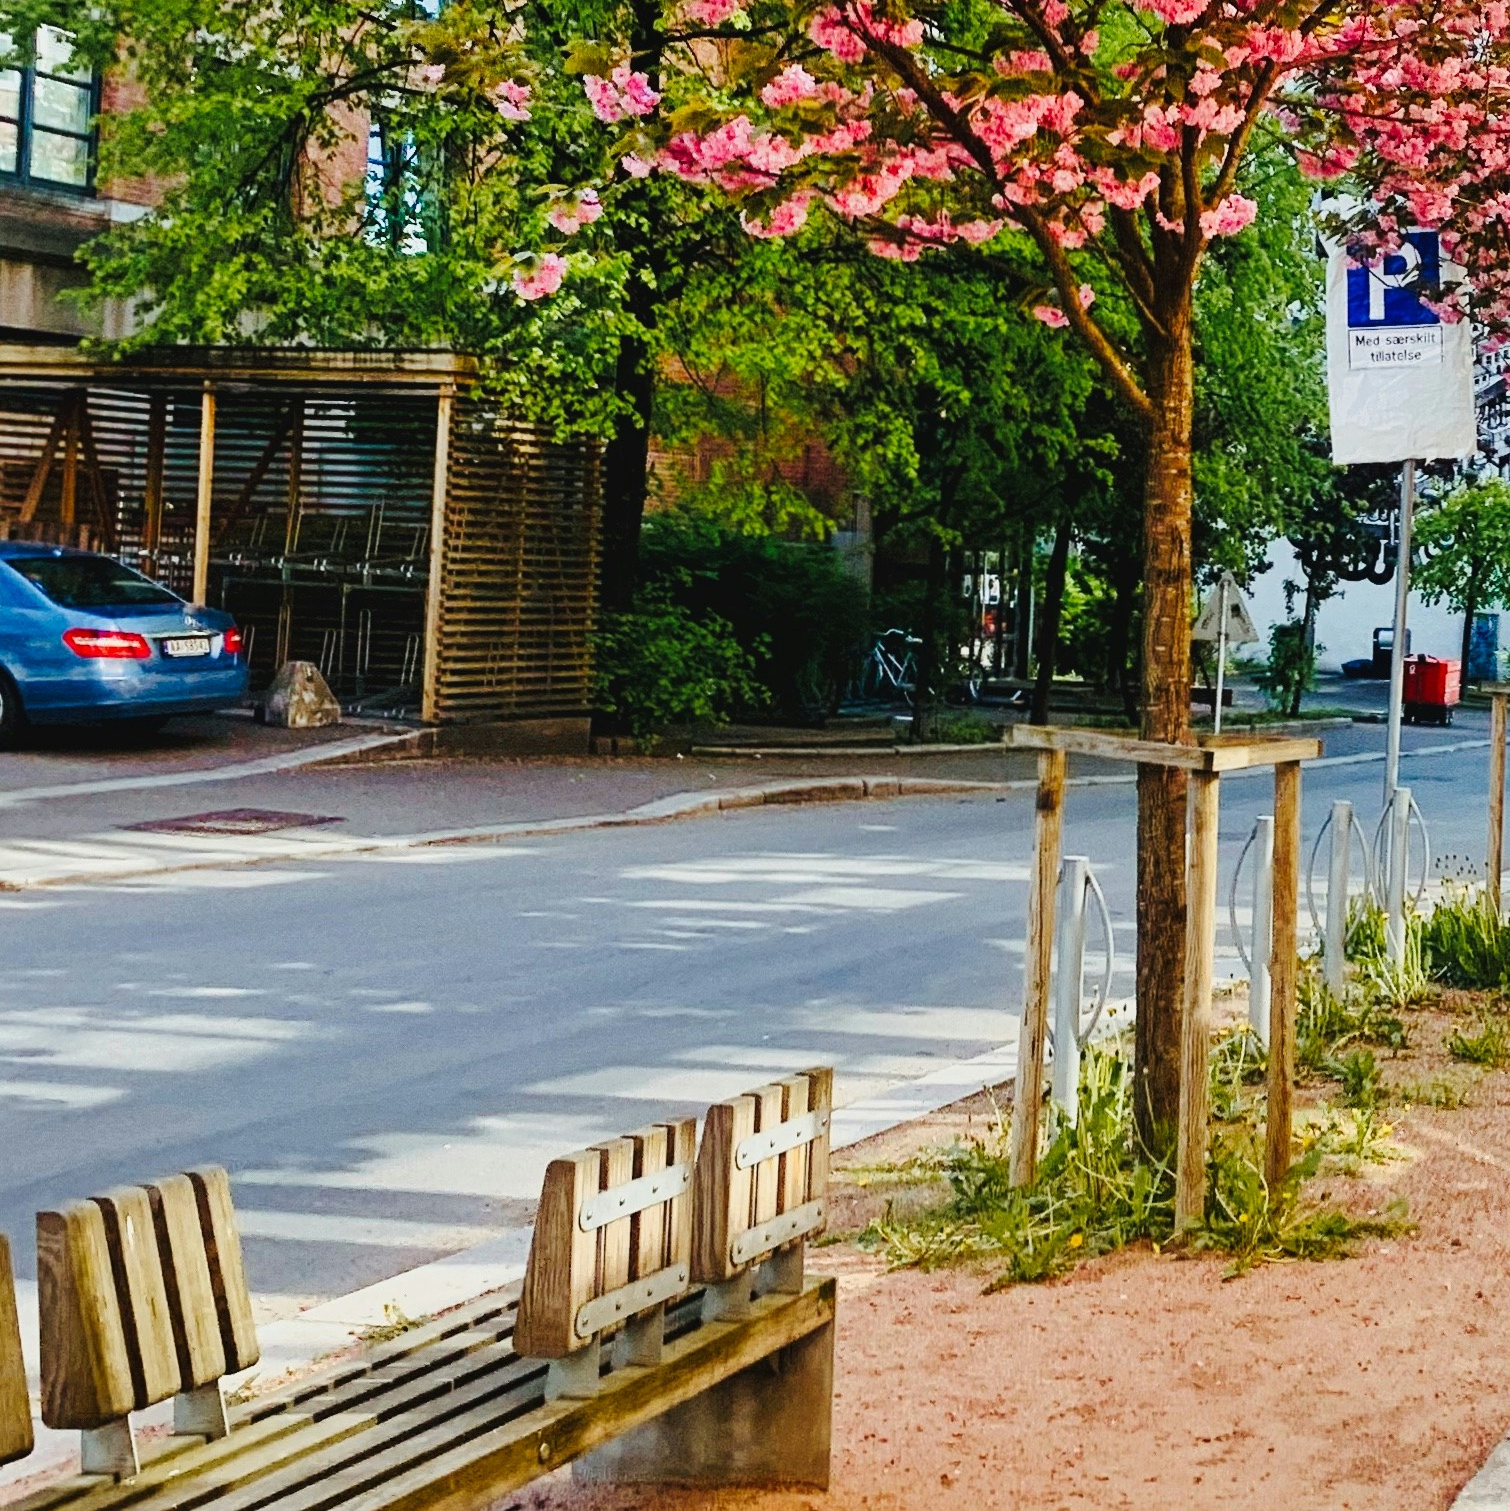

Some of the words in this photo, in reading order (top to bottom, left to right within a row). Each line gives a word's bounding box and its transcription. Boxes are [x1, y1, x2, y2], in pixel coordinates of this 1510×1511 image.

[1355, 335, 1380, 347] Med
[1385, 332, 1436, 346] særskilt
[1370, 350, 1422, 362] tillatelse
